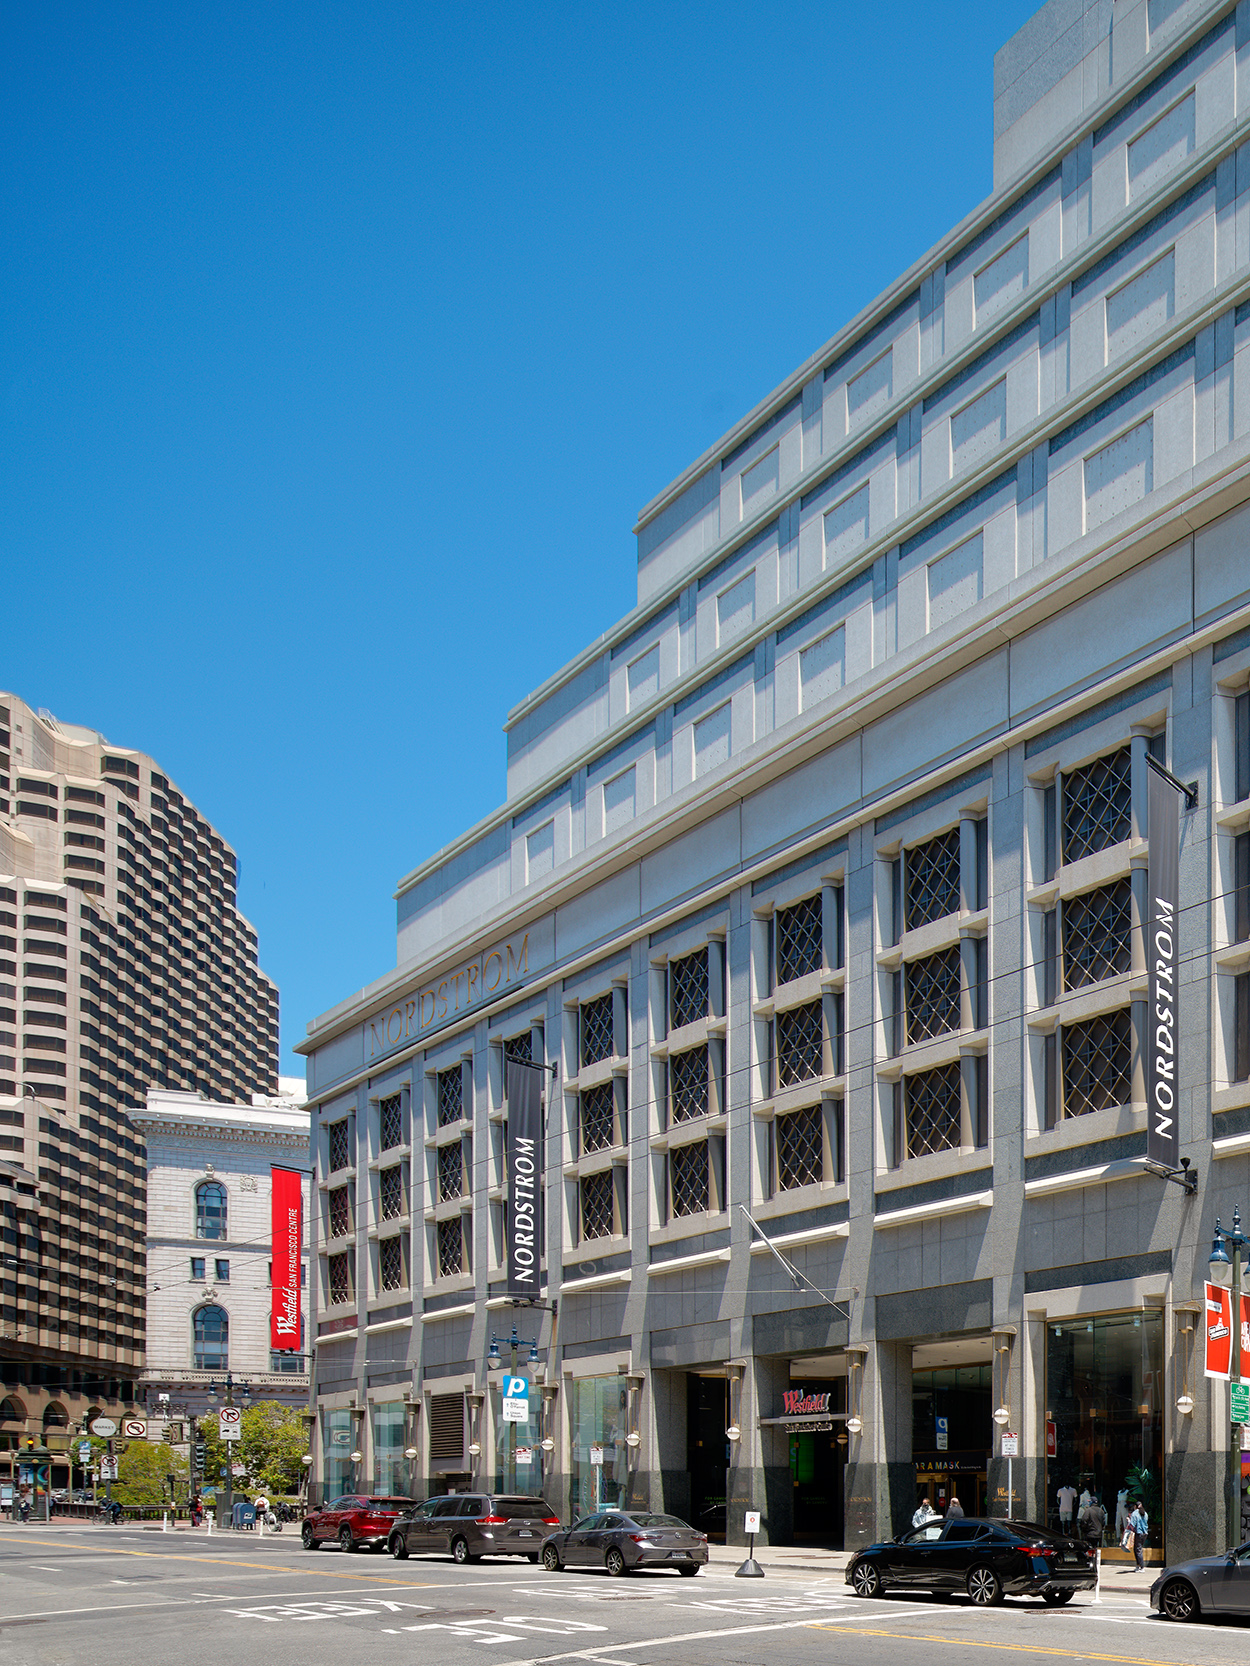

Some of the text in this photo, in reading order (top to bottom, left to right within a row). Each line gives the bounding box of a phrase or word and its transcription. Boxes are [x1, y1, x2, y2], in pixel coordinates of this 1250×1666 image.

[370, 932, 530, 1057] NORDSTROM
[1154, 896, 1175, 1140] NORDSTROM
[276, 1208, 298, 1336] Westfield SAN FRANCISCO CENTRE
[513, 1137, 535, 1284] NORDSTROM
[782, 1389, 830, 1414] Westfield
[934, 1460, 960, 1471] MASK
